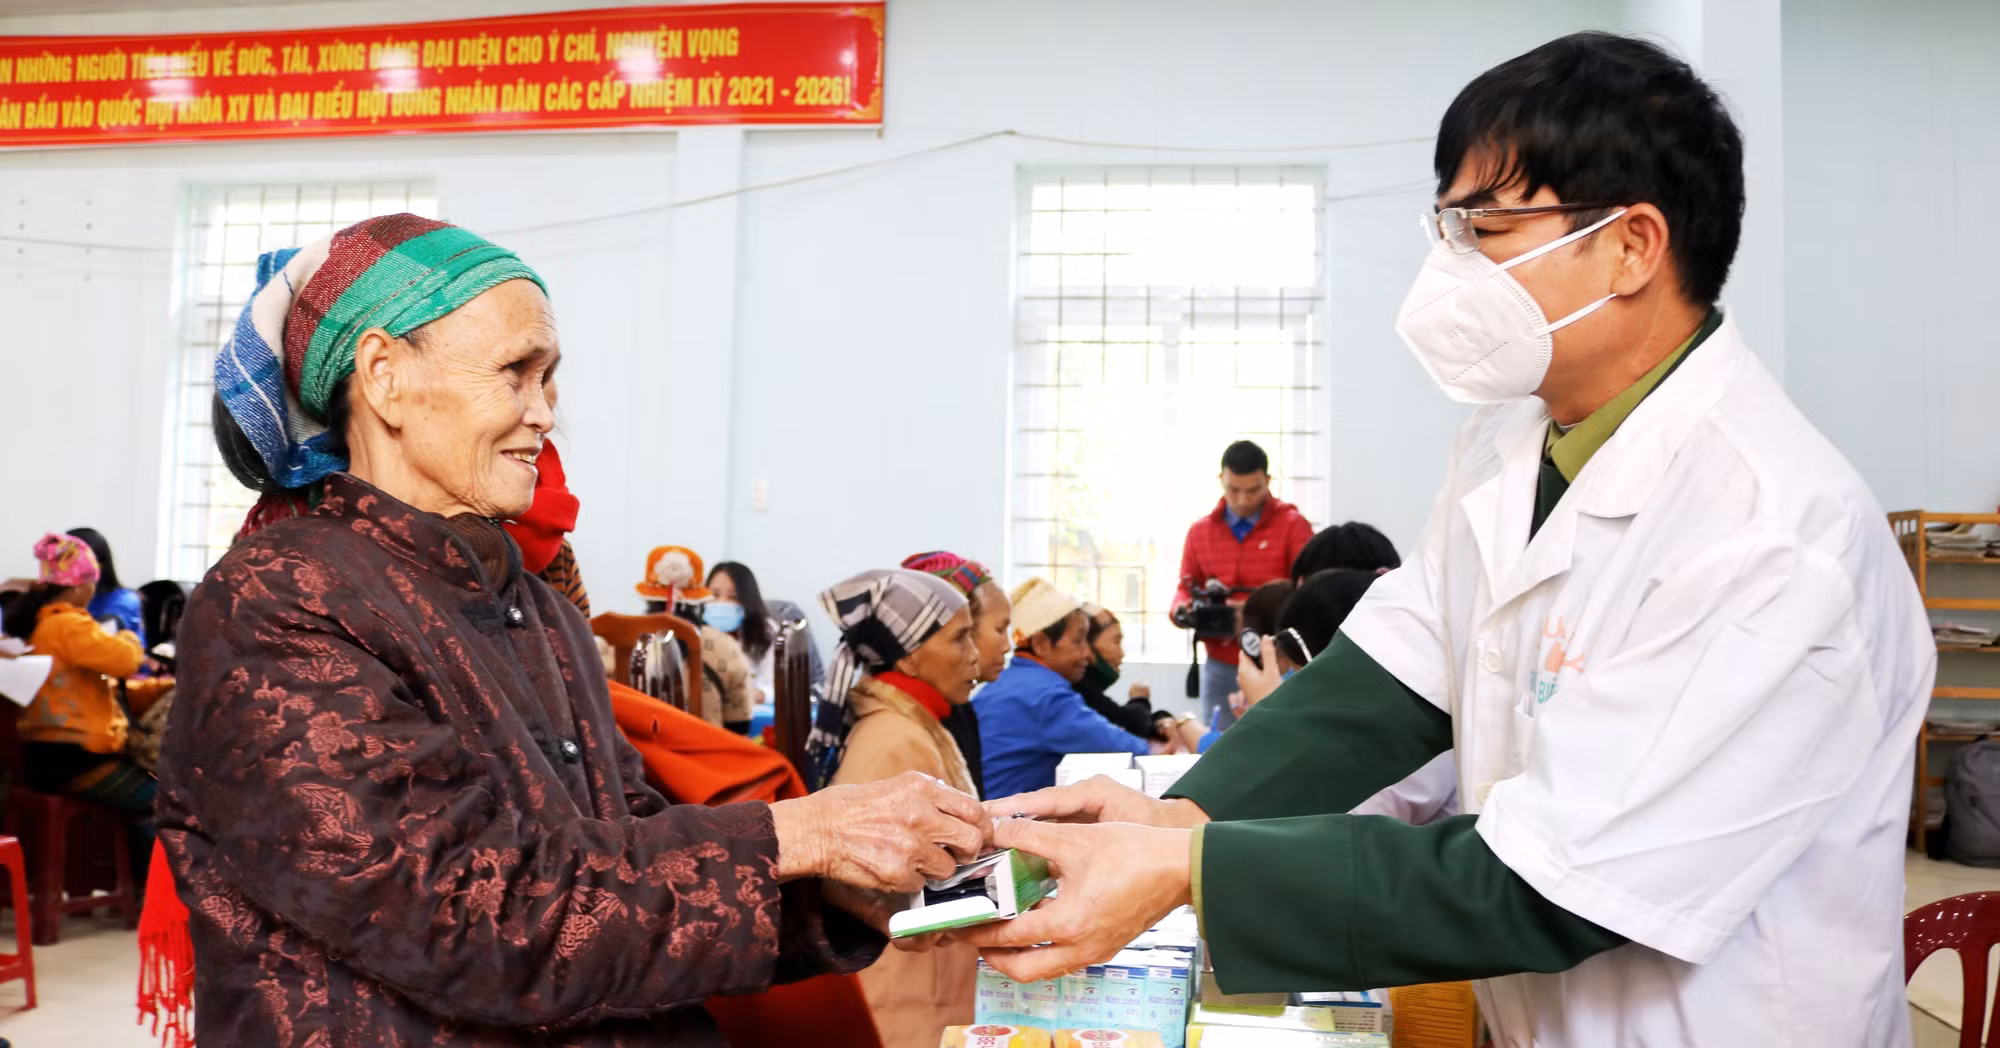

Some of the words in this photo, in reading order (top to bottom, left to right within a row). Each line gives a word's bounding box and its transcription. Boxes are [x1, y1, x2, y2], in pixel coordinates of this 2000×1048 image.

[16, 50, 73, 84] NHỮNG
[76, 47, 128, 82] NGƯỜI
[317, 38, 365, 72] XỨNG
[423, 38, 455, 75] ĐẠI
[457, 31, 502, 73] DIỆN
[505, 34, 543, 65] CHO
[547, 27, 560, 64] Ý
[687, 26, 740, 64] VỌNG
[61, 93, 95, 128] VÀO
[97, 87, 142, 130] QUỐC
[176, 90, 223, 125] KHÓA
[225, 94, 250, 123] XV
[253, 87, 276, 122] VÀ
[278, 91, 310, 127] ĐẠI
[312, 79, 355, 121] BIỂU
[356, 83, 388, 124] HỘI
[445, 79, 498, 115] NHÂN
[501, 77, 541, 113] DÂN
[544, 75, 583, 112] CÁC
[586, 70, 627, 111] CẤP
[629, 71, 694, 115] NHIỆM
[727, 75, 775, 107] 2021
[794, 75, 852, 107] 2026!
